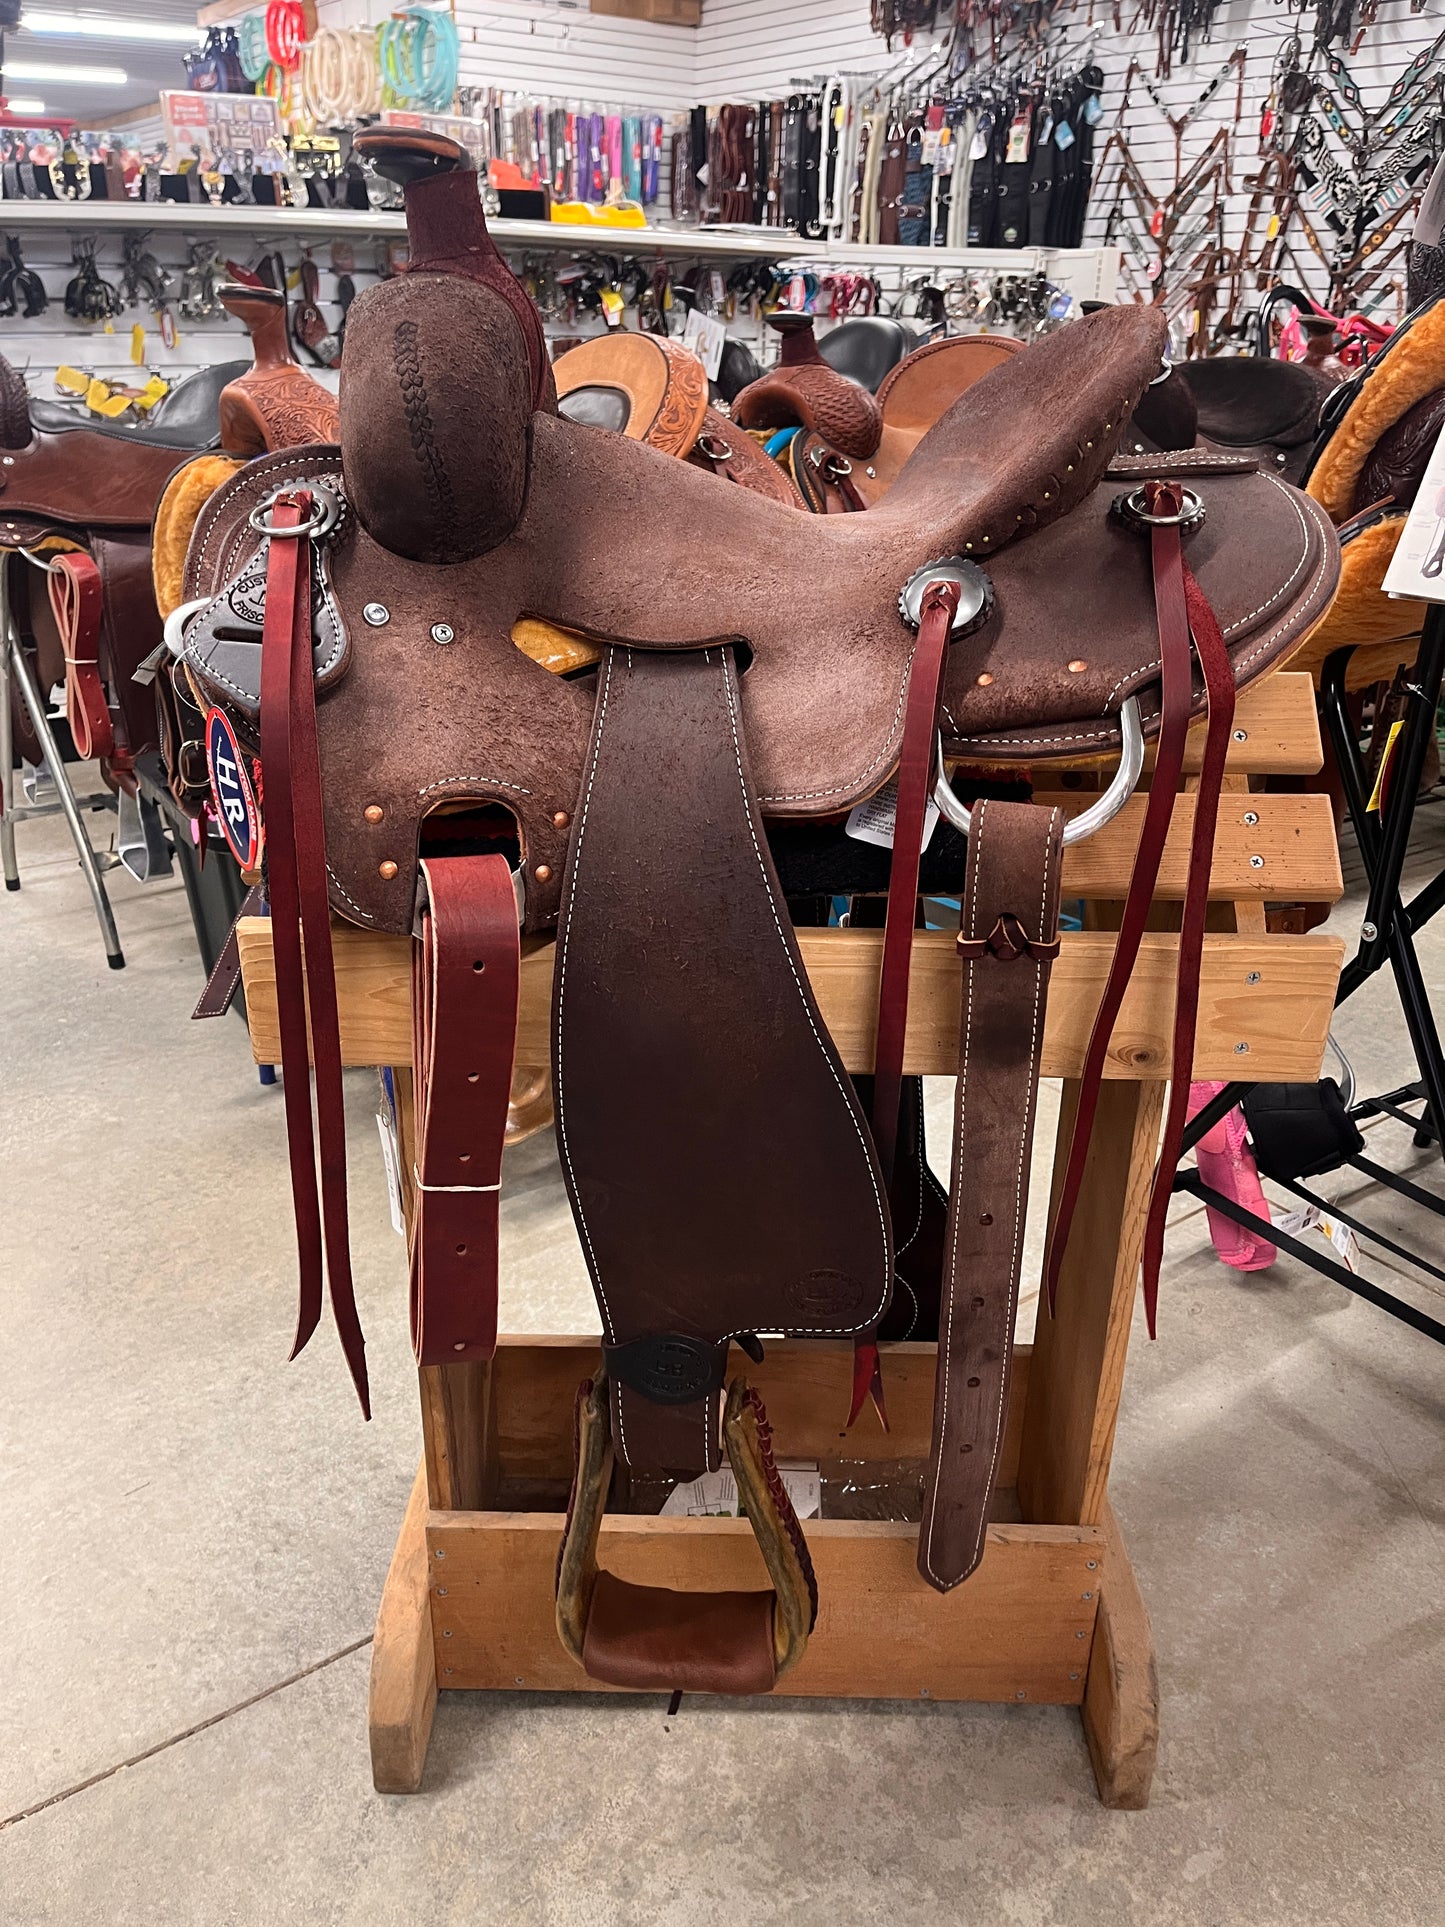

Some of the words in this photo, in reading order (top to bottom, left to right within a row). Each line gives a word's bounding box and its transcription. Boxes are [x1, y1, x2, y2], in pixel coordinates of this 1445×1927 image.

[247, 801, 258, 841] MADE
[861, 823, 876, 831] United
[876, 828, 891, 836] States
